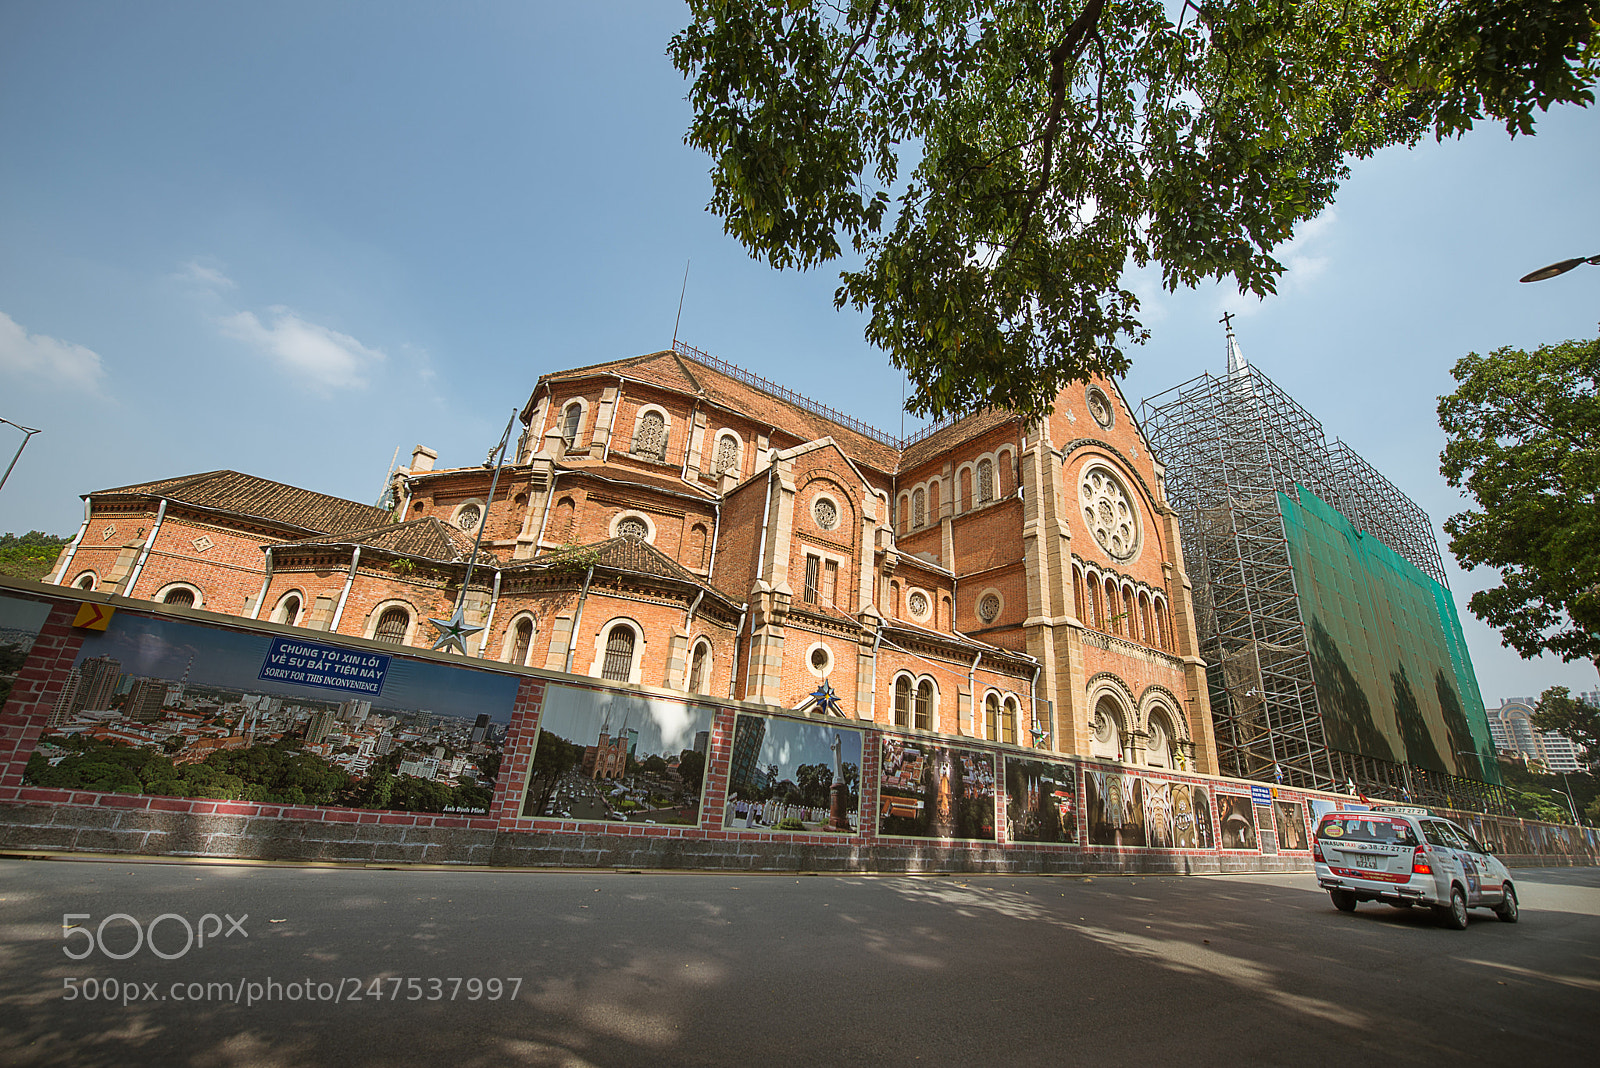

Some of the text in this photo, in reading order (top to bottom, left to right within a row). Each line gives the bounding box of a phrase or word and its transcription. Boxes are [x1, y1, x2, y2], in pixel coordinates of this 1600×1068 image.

[280, 644, 319, 658] CHÚNG
[321, 650, 341, 661] TÔI
[342, 654, 361, 665] XIN
[264, 667, 379, 692] SORRY FOR THIS INCONVENIENCE
[334, 664, 359, 675] TIỆN
